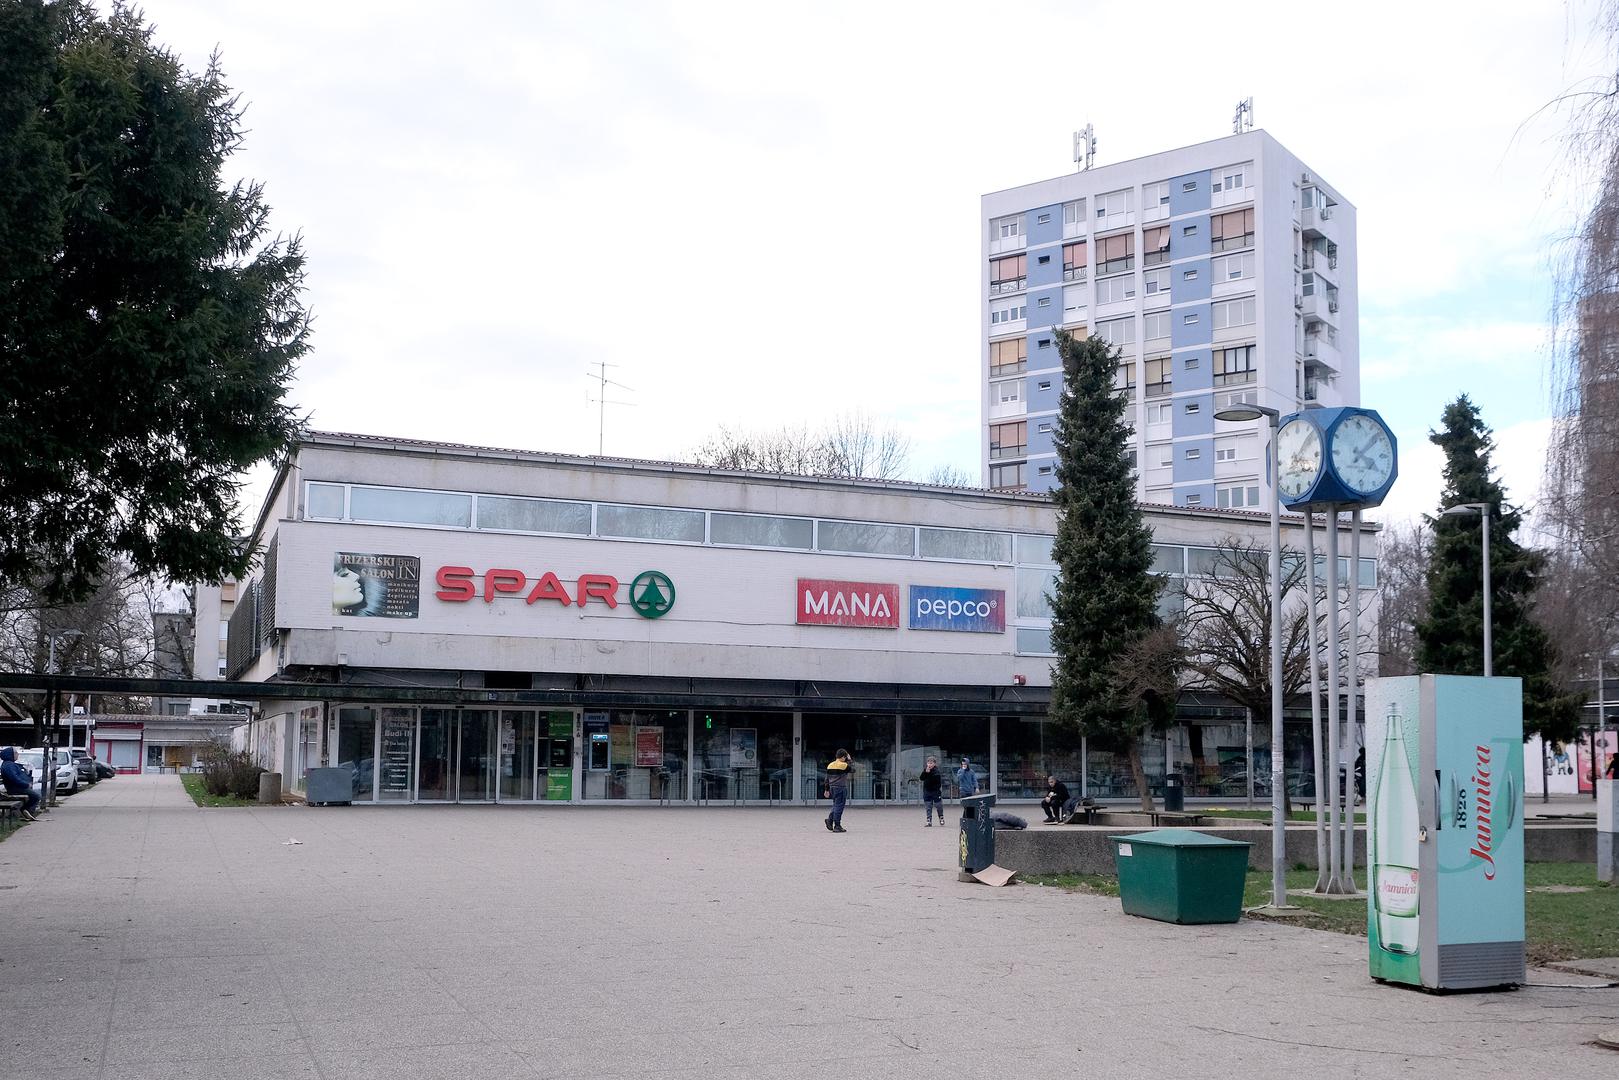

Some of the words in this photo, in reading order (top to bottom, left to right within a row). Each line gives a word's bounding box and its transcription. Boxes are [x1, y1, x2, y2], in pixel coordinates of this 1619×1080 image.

[337, 555, 395, 567] FRIZERSKI
[360, 568, 395, 579] SALON
[398, 566, 417, 580] IN
[435, 565, 619, 609] SPAR
[805, 589, 891, 618] MANA
[1470, 744, 1496, 881] Jamnica
